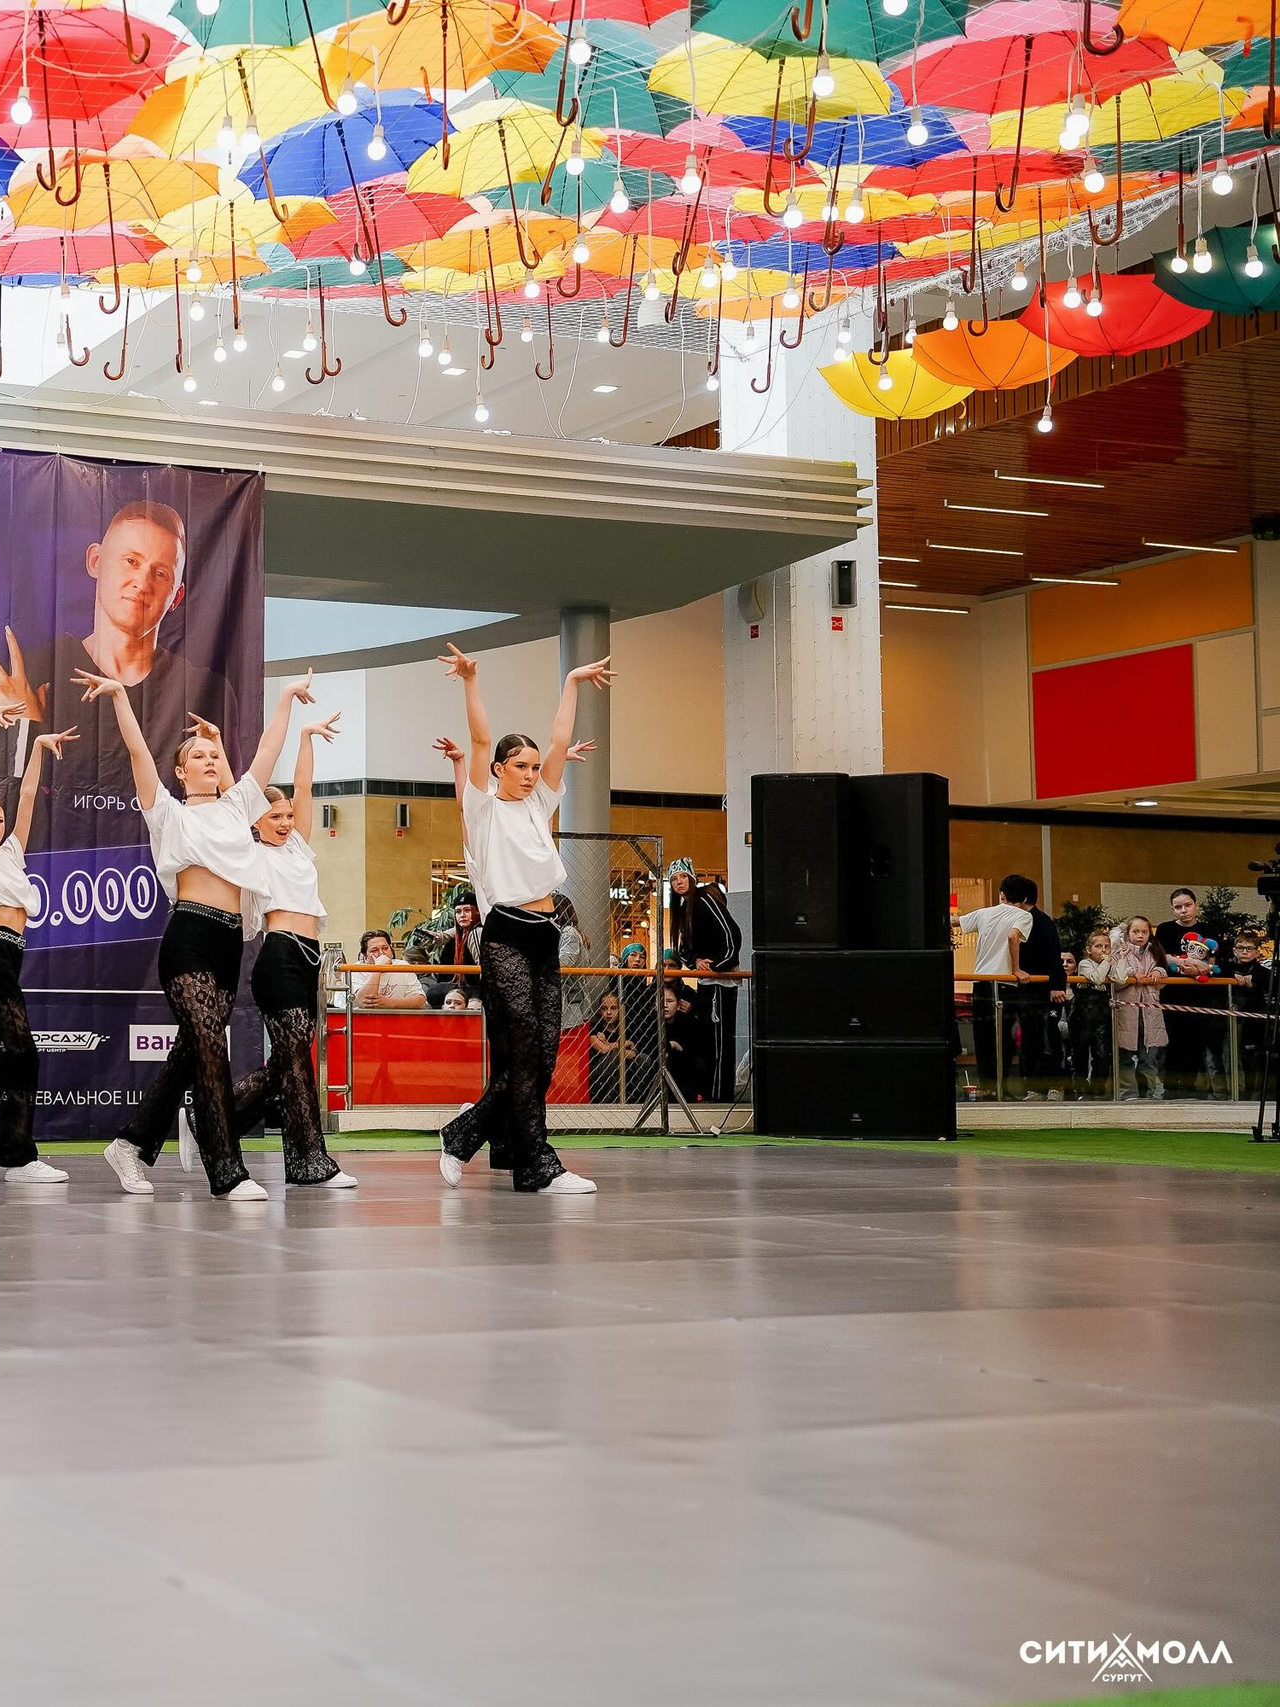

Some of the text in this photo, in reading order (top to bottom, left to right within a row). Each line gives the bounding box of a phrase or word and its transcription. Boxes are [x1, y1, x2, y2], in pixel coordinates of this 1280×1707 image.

[74, 795, 126, 811] ИГОРЬ
[32, 1034, 87, 1043] ОРСАЖ
[136, 1036, 175, 1050] ван
